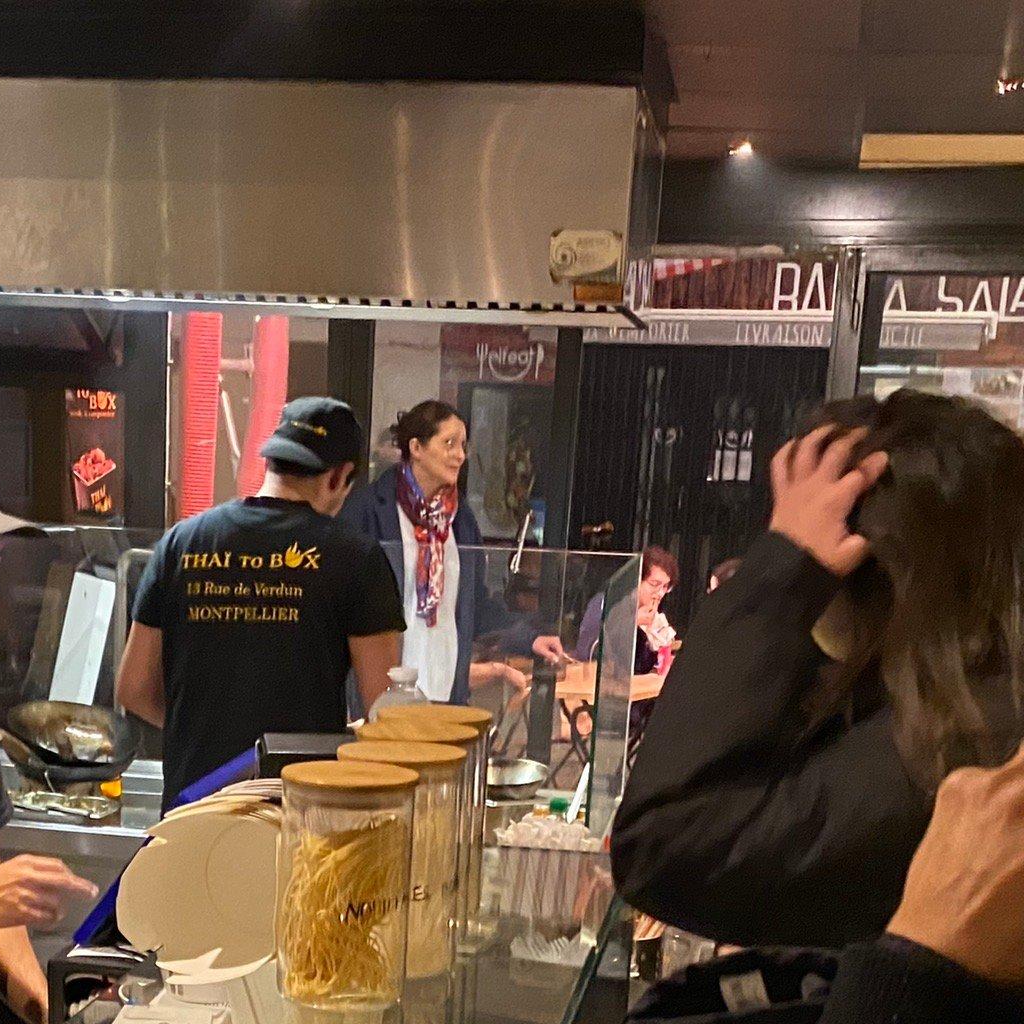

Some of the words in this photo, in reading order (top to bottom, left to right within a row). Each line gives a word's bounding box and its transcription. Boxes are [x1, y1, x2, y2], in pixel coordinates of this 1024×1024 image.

[773, 262, 839, 312] BA
[736, 323, 826, 346] LIVRAISON
[204, 581, 231, 596] Rue
[234, 582, 251, 597] de
[254, 582, 304, 598] Verdun
[188, 606, 300, 622] MONTPELLIER
